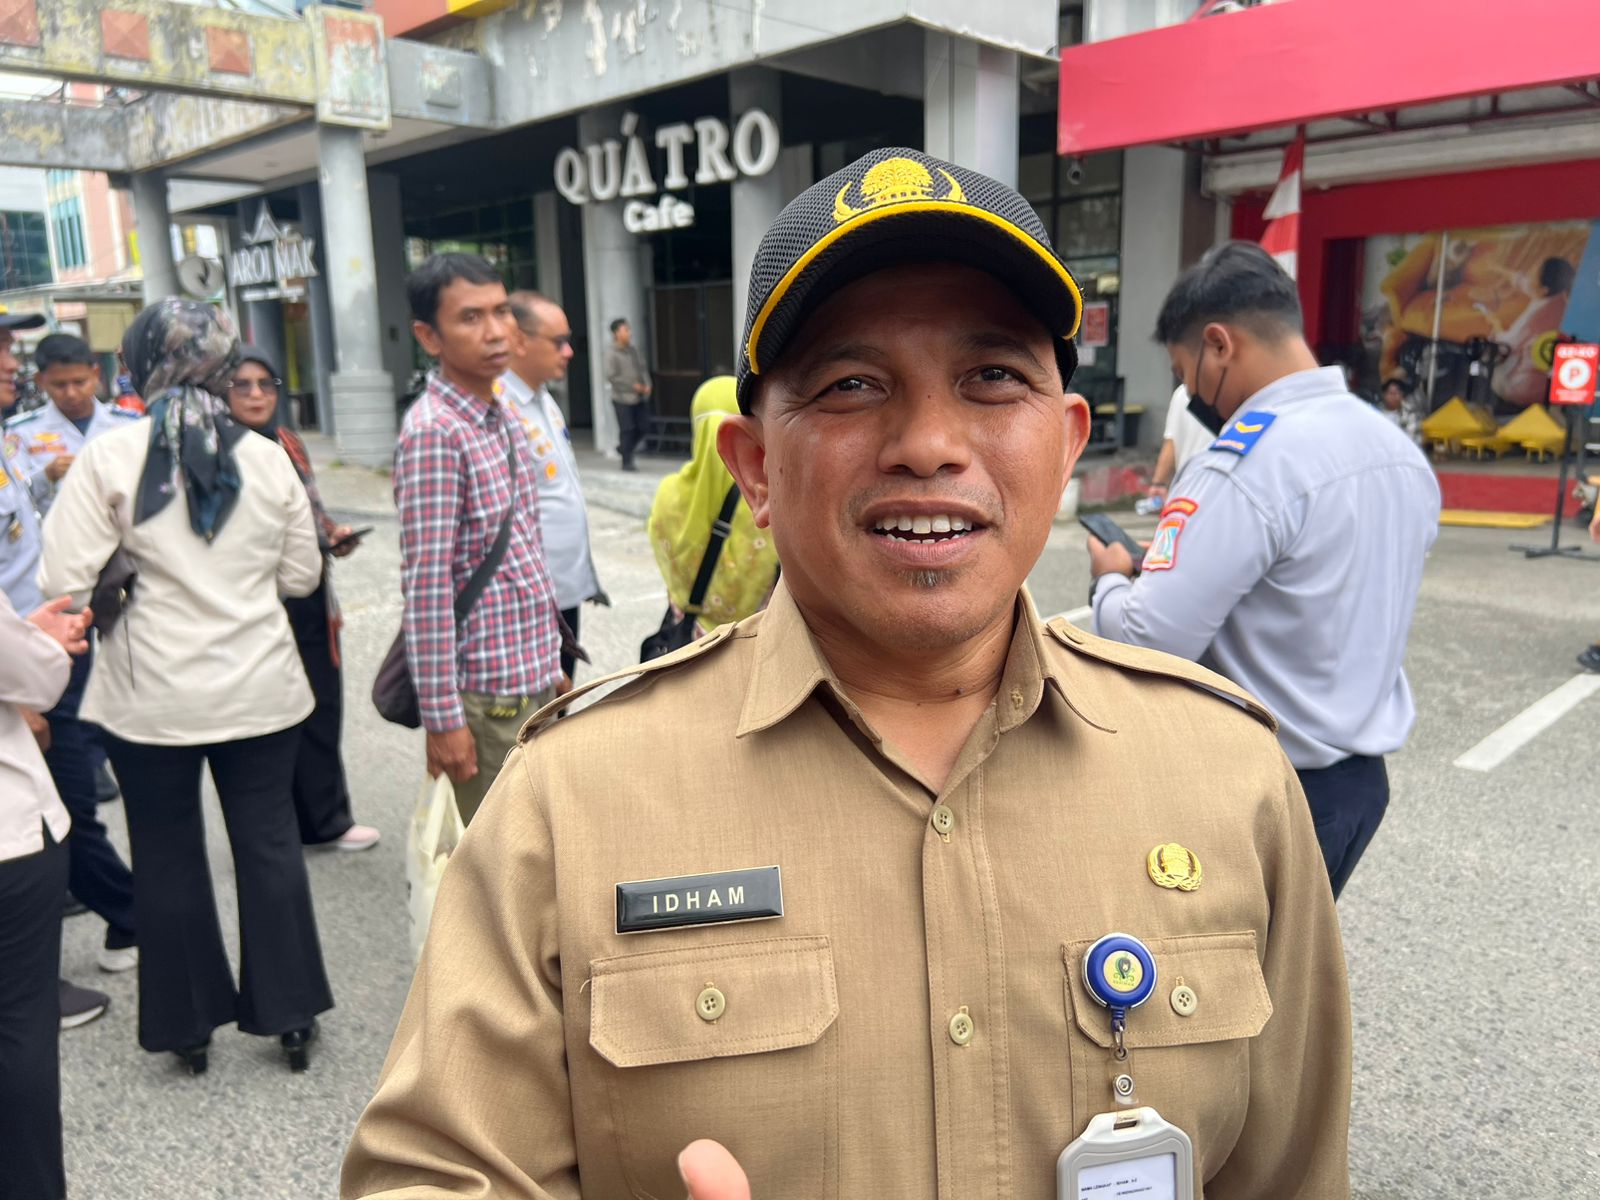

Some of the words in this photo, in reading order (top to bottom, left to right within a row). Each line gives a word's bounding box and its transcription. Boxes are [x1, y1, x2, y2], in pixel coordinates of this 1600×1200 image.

[623, 193, 695, 233] Cafe
[273, 237, 319, 281] MAK
[652, 885, 745, 914] IDHAM
